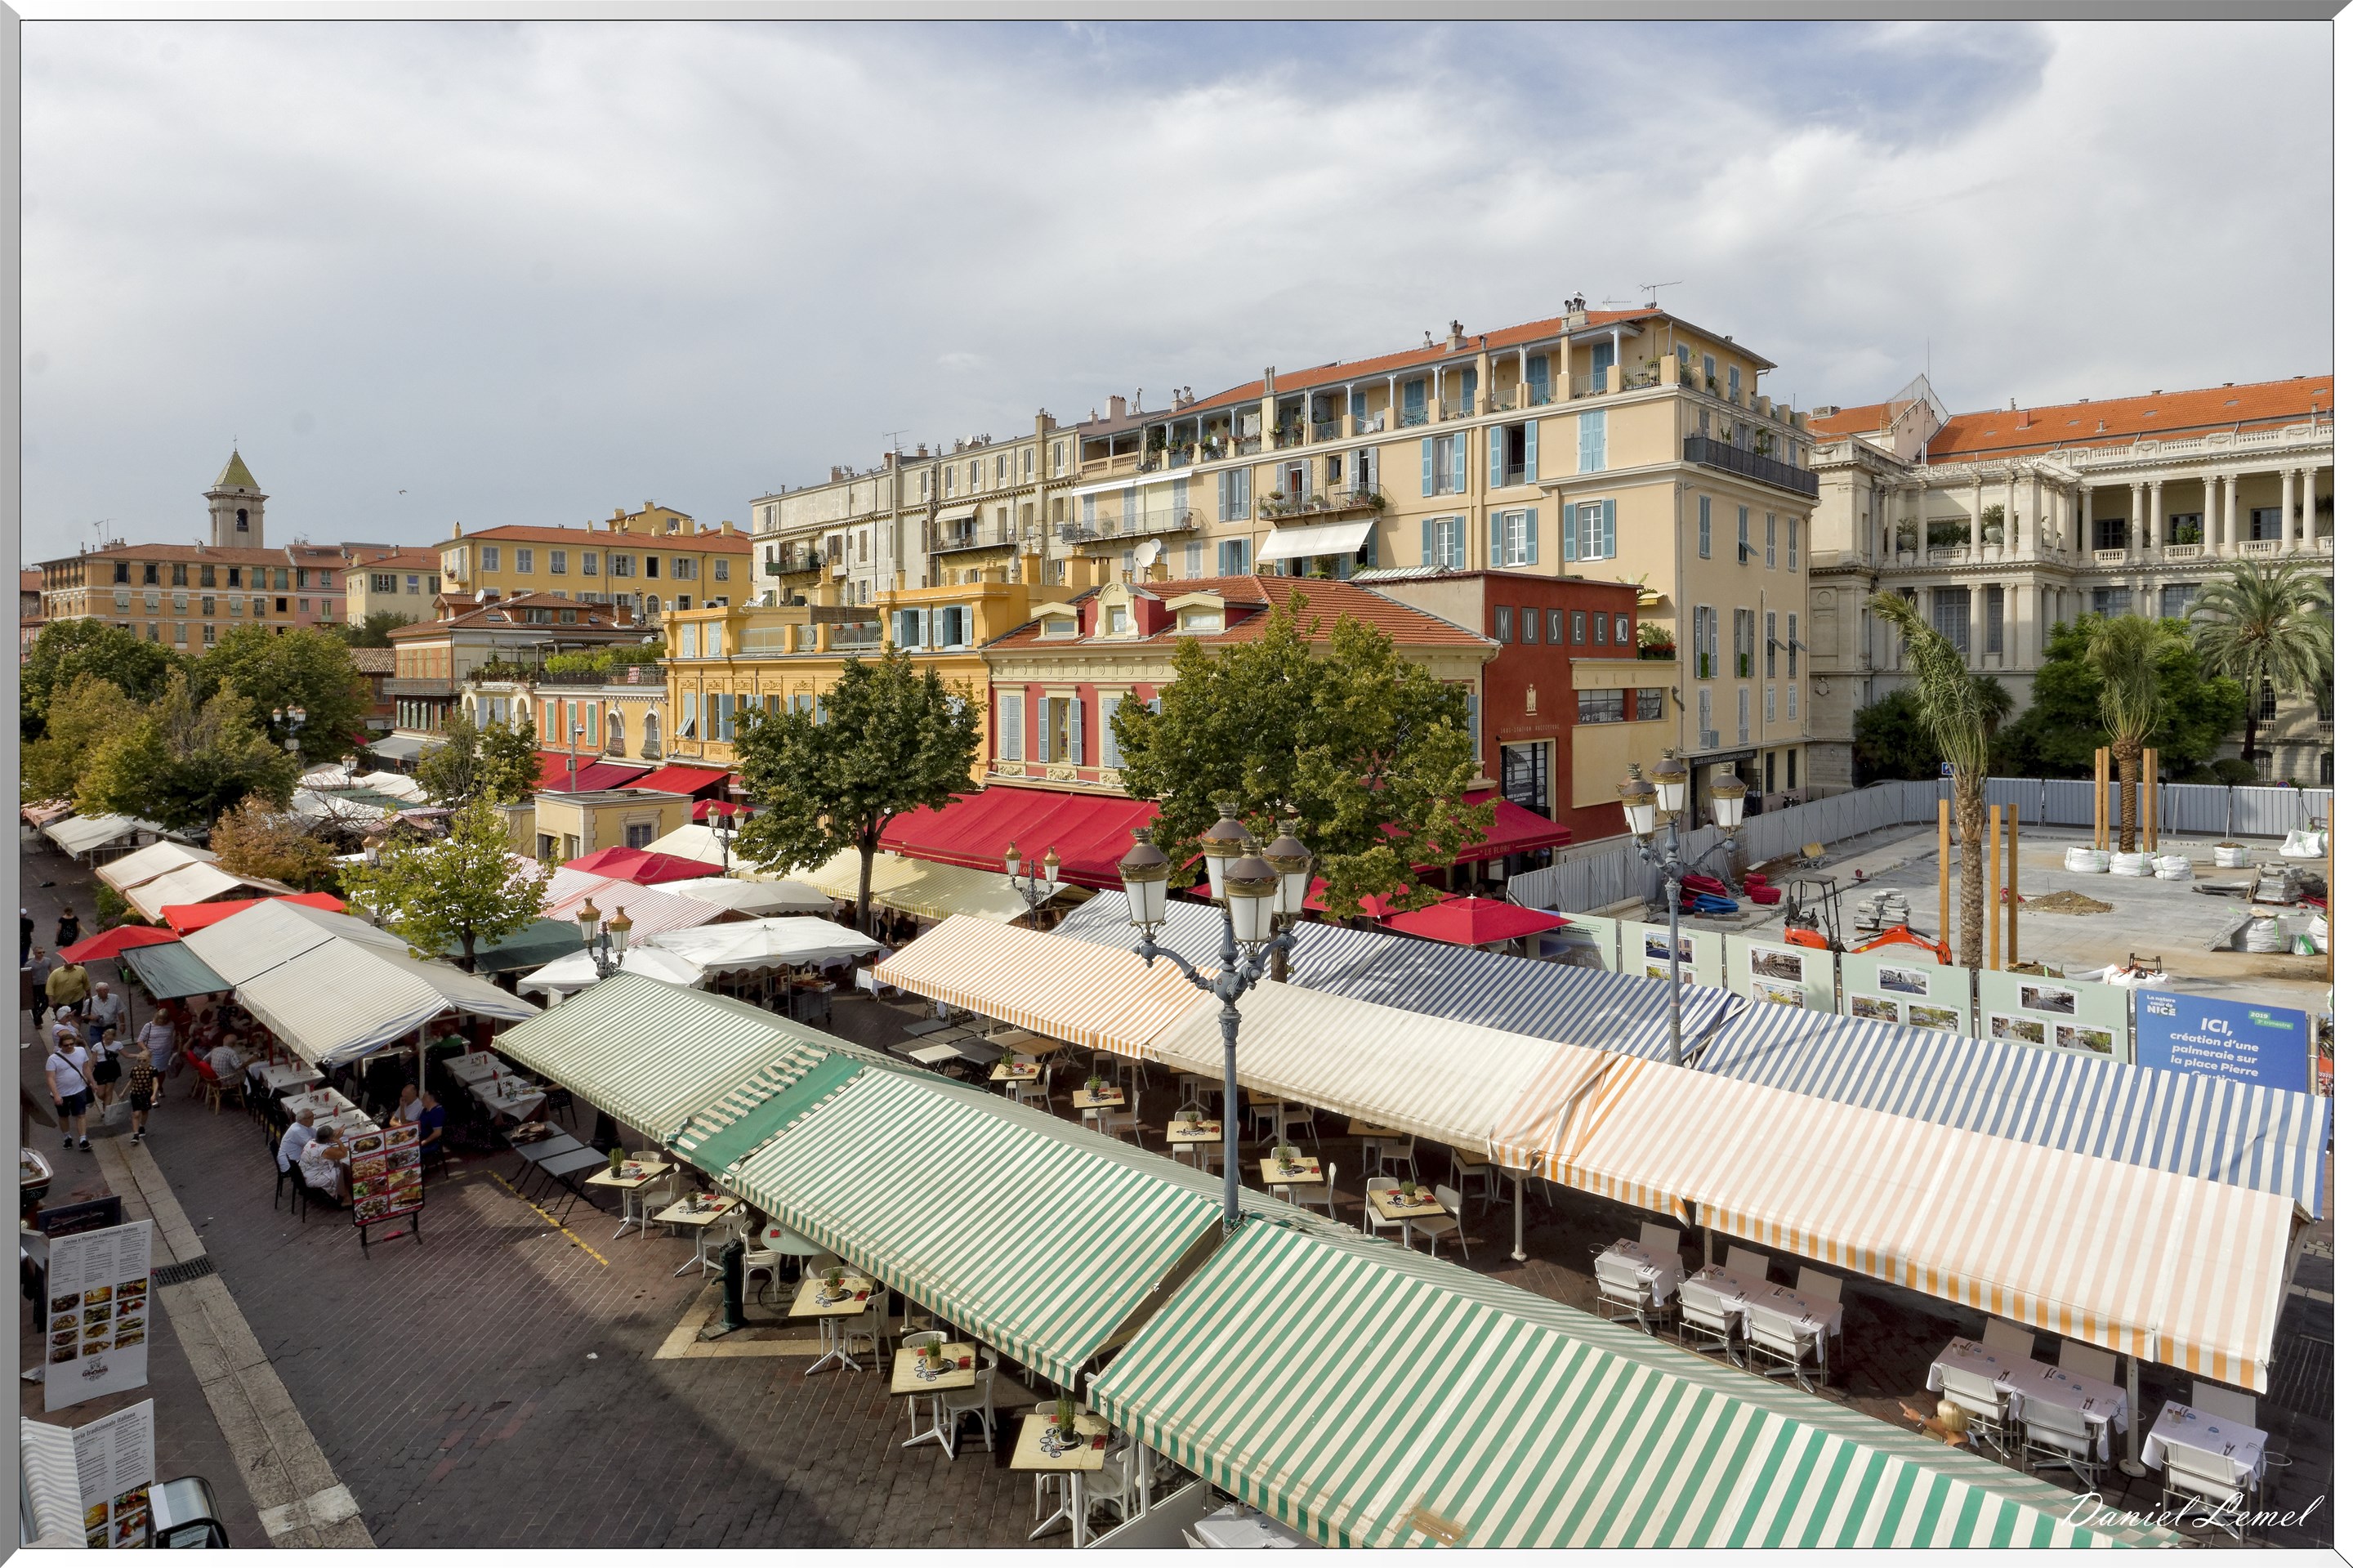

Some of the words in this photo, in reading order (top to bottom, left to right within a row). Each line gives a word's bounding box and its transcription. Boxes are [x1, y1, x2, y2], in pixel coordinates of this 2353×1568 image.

[1485, 848, 1492, 856] LE
[1494, 844, 1511, 855] FLORE
[2147, 1005, 2176, 1016] NICE
[2200, 1017, 2233, 1037] ICI,
[2170, 1033, 2221, 1046] création
[2172, 1045, 2235, 1061] palmeraie
[2236, 1055, 2257, 1064] sur
[2170, 1054, 2182, 1065] la
[2184, 1058, 2218, 1070] place
[2220, 1062, 2259, 1077] Pierre
[86, 1420, 116, 1436] tradizionale
[117, 1412, 136, 1423] italiana
